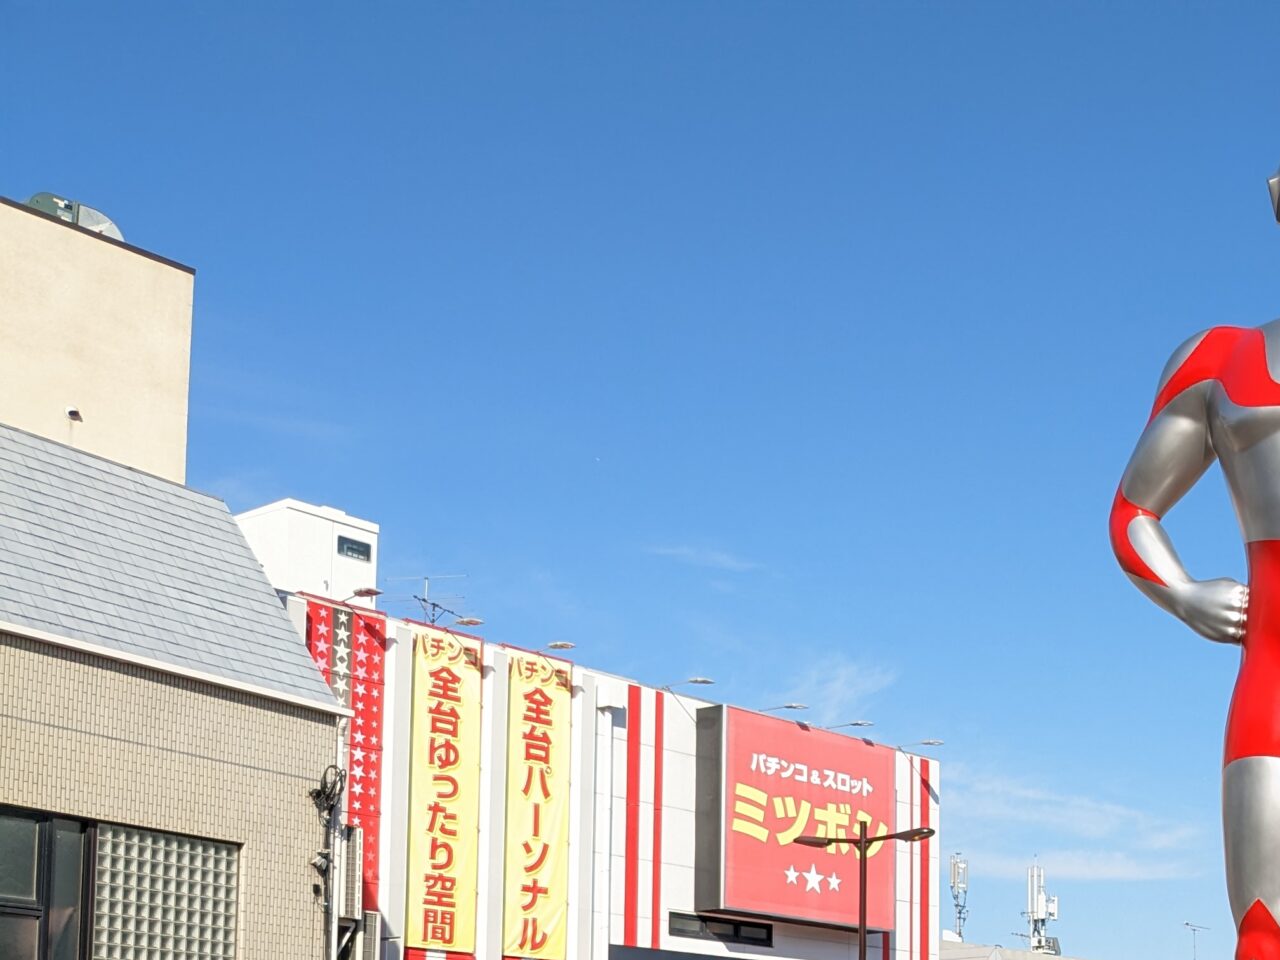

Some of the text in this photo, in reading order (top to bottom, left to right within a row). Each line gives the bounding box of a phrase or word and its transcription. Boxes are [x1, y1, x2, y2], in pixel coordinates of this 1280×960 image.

[412, 633, 481, 669] パチンコ
[508, 656, 573, 692] パチンコ
[421, 665, 463, 946] 全台ゆったり空間
[517, 686, 555, 952] 全台パーソナル
[731, 782, 889, 860] ミツボシ
